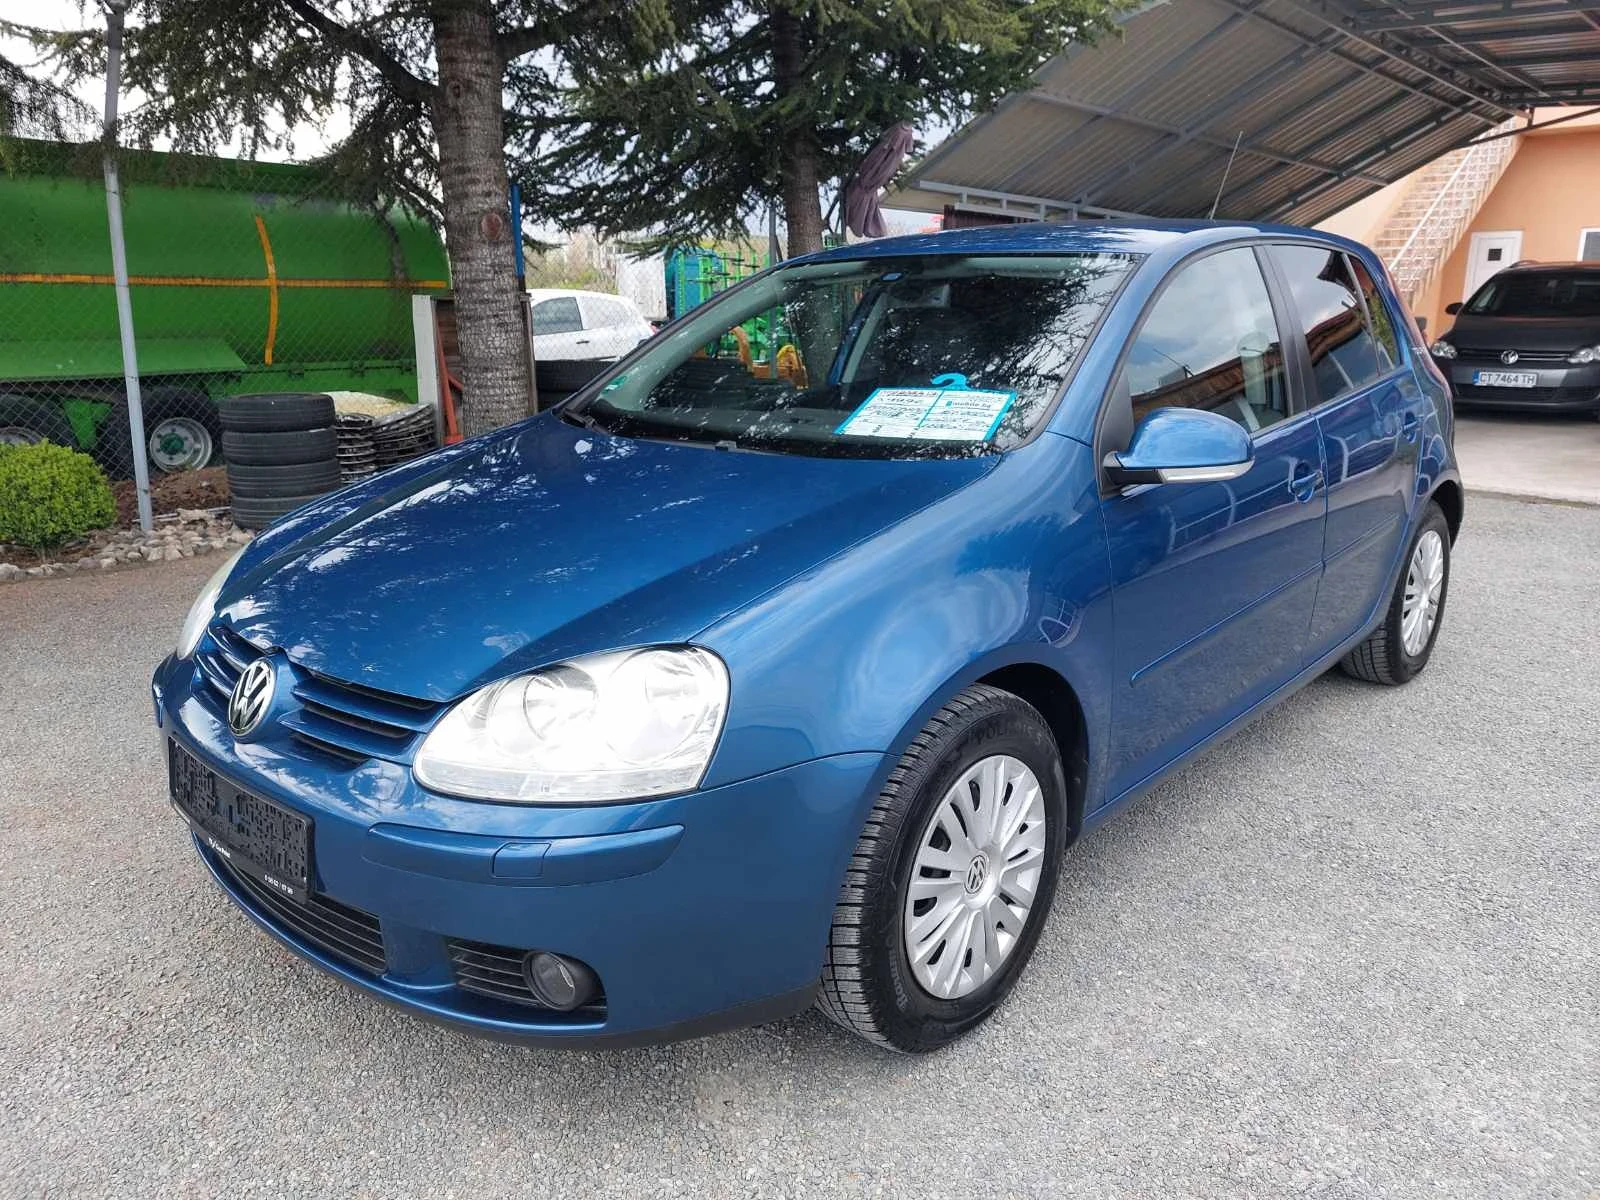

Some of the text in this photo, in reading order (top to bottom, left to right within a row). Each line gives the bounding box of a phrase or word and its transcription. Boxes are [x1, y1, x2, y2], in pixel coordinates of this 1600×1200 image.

[1480, 372, 1536, 386] CT 7464 TH
